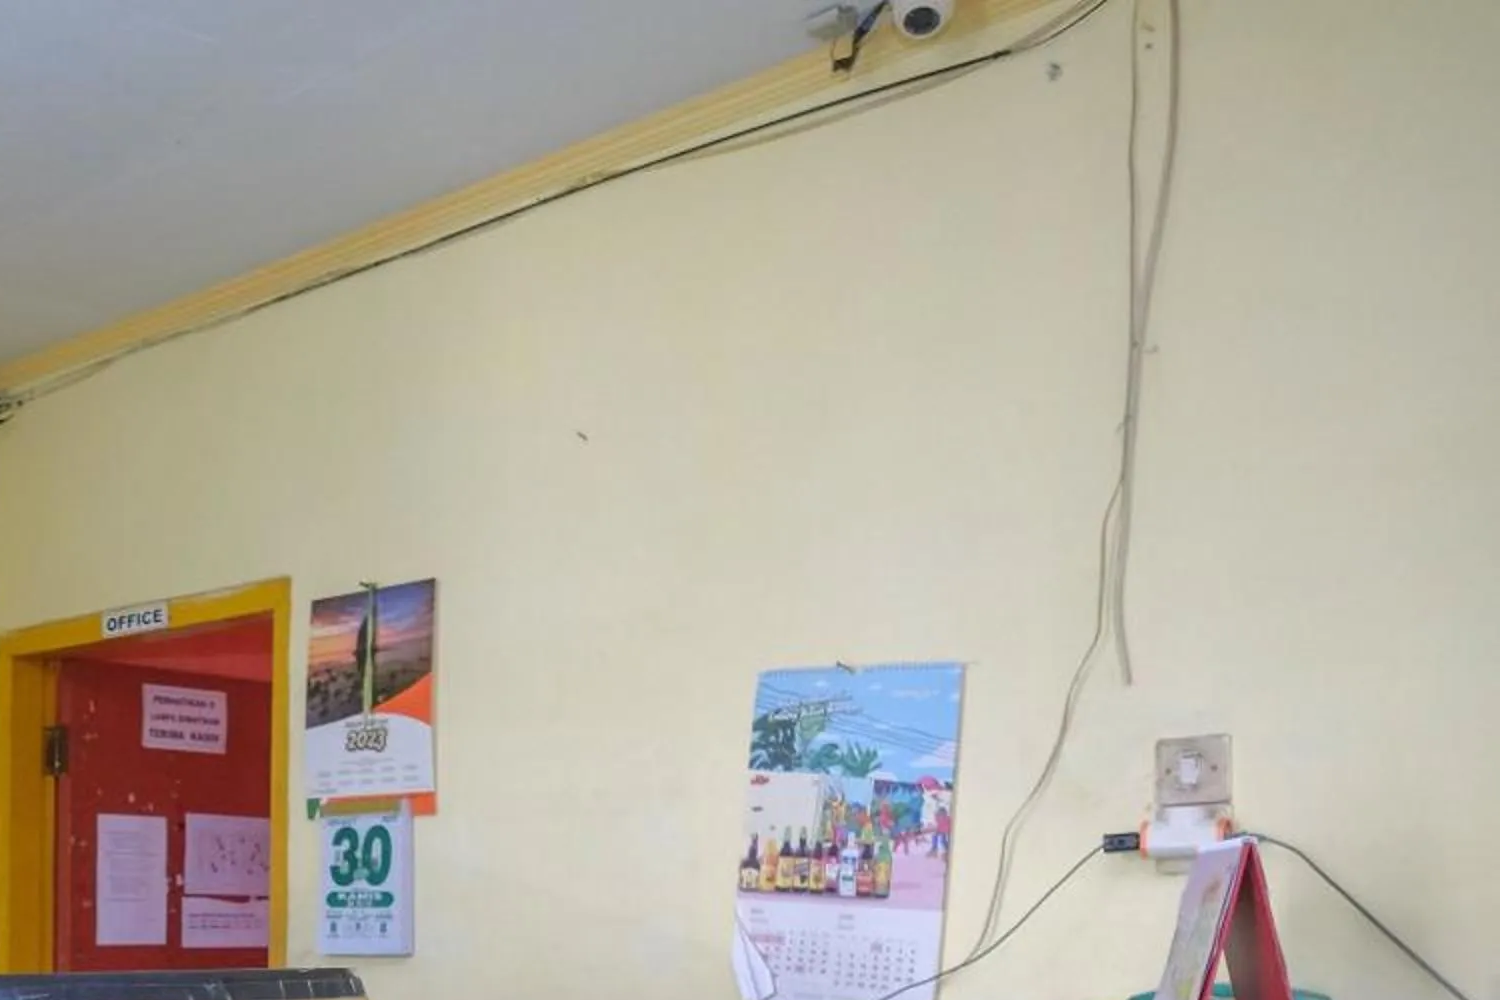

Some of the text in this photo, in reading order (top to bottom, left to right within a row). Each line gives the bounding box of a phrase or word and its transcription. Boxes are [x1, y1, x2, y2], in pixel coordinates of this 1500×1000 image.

[106, 608, 164, 631] OFFICE
[345, 727, 388, 753] 2023
[329, 824, 393, 887] 30
